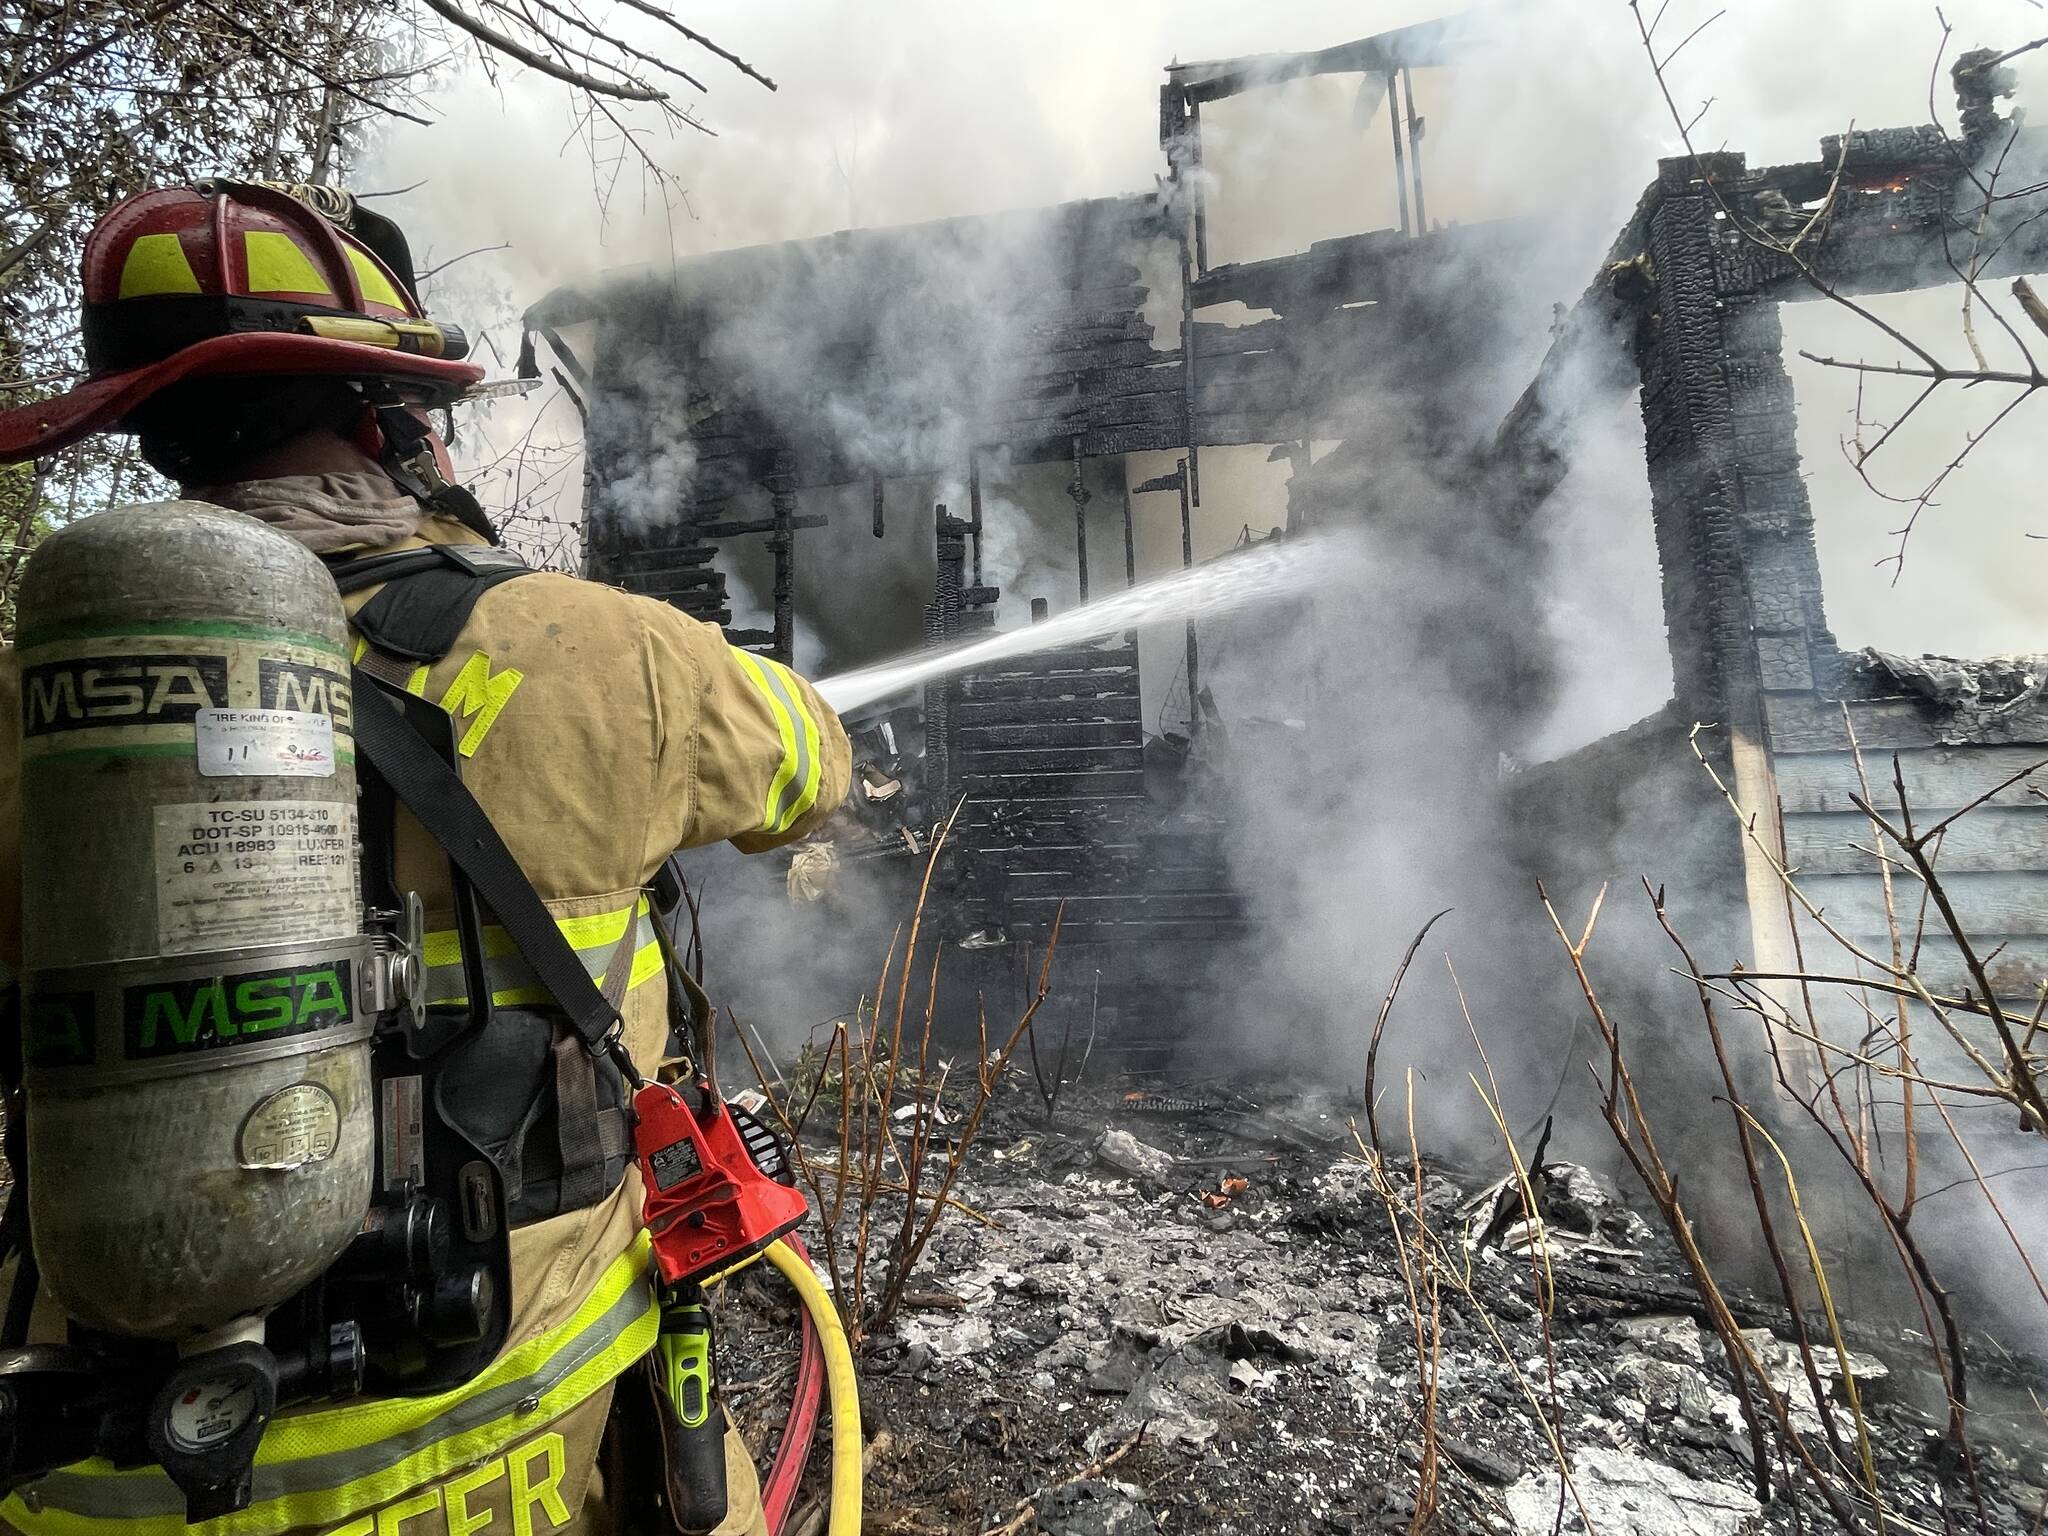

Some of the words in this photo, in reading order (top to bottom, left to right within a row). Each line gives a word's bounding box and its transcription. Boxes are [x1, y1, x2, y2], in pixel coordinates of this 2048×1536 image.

[28, 666, 214, 733] MSA
[209, 713, 237, 723] IRE
[240, 713, 270, 723] KING
[209, 810, 265, 823] TC-SU
[270, 810, 328, 821] 5134-310
[193, 825, 262, 840] DOT-SP
[226, 840, 276, 853] 18983
[298, 838, 344, 851] LUXFER
[330, 854, 345, 866] 121
[184, 861, 195, 874] 6
[141, 970, 347, 1048] MSA
